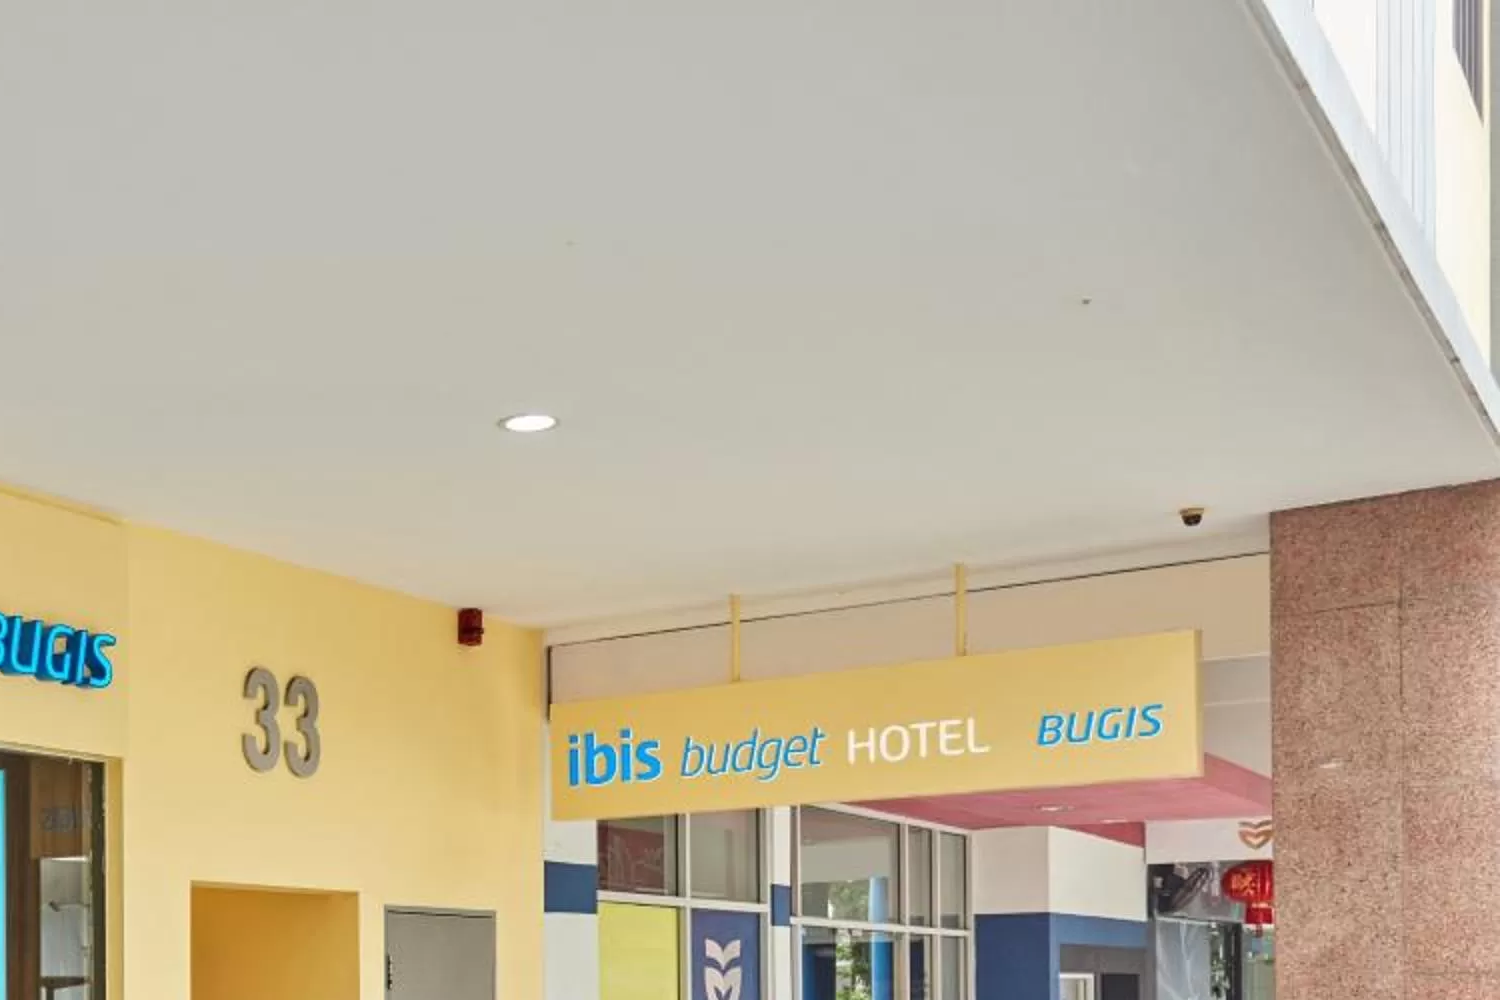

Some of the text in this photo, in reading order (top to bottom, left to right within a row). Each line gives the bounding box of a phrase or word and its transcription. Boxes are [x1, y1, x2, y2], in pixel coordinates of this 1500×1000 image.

[242, 666, 322, 777] 33
[567, 703, 1164, 788] ibis budget HOTEL BUGIS
